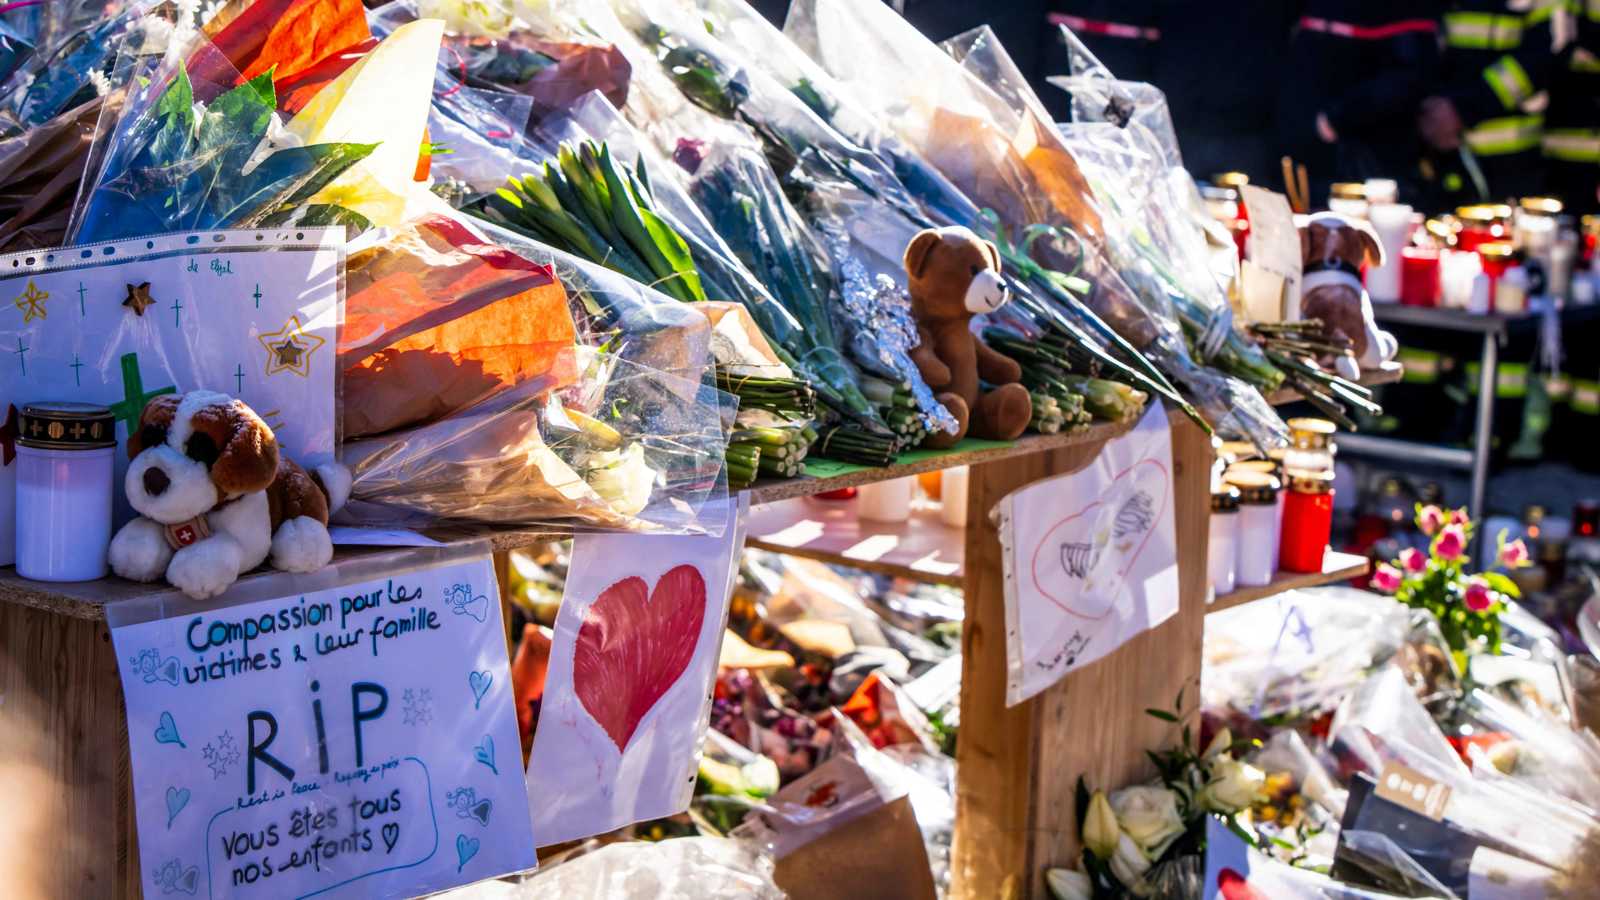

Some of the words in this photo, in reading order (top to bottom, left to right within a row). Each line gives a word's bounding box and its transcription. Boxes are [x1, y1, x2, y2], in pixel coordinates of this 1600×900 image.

[183, 648, 282, 684] victimes
[315, 628, 364, 656] leur
[369, 606, 442, 656] famille
[186, 597, 333, 653] Compassion
[340, 589, 384, 630] pour
[387, 579, 423, 604] les
[288, 805, 339, 839] êtes
[348, 789, 402, 828] tous
[232, 855, 274, 887] nos
[277, 827, 374, 873] enfants
